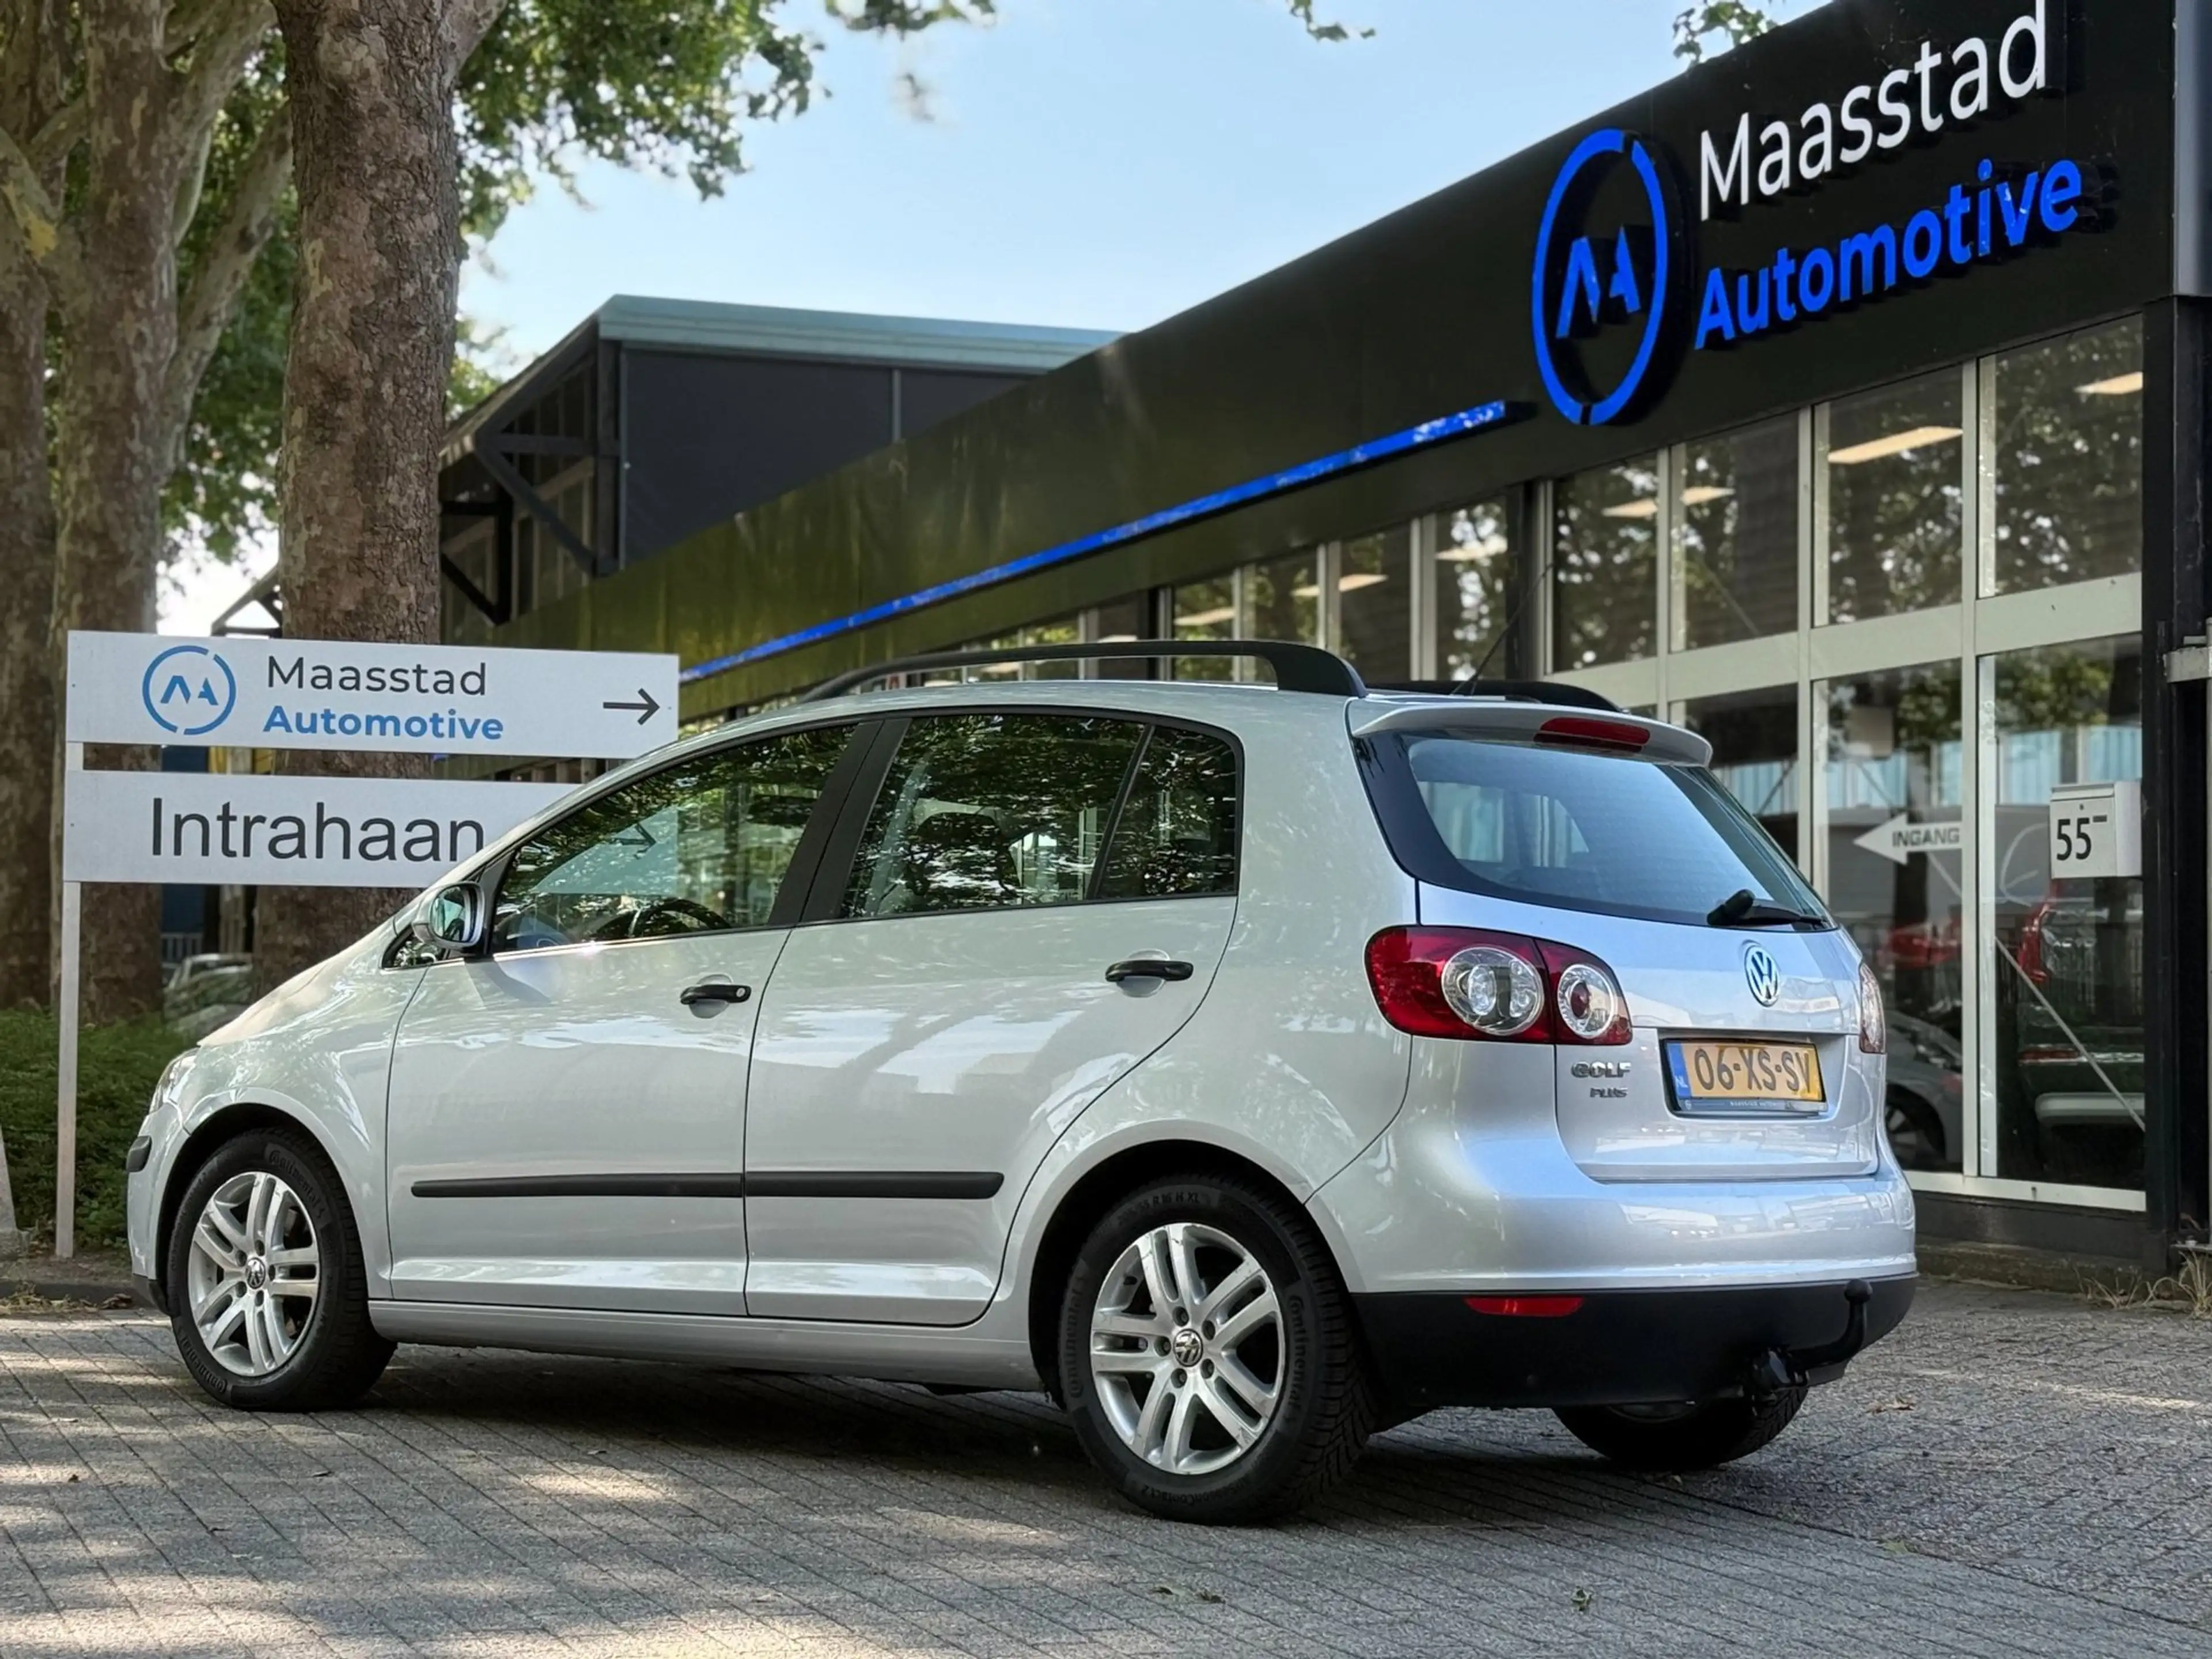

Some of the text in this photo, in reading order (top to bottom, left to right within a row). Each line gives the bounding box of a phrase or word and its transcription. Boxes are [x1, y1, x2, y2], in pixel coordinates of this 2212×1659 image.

[1700, 0, 2046, 221] Maasstad
[1695, 158, 2082, 349] Automotive
[268, 656, 487, 695] Maasstad
[263, 706, 503, 740] Automotive
[152, 798, 484, 862] Intrahaan
[1892, 827, 1960, 847] INGANG
[1570, 1060, 1631, 1078] GOLF
[1694, 1047, 1810, 1093] 06-XS-SV
